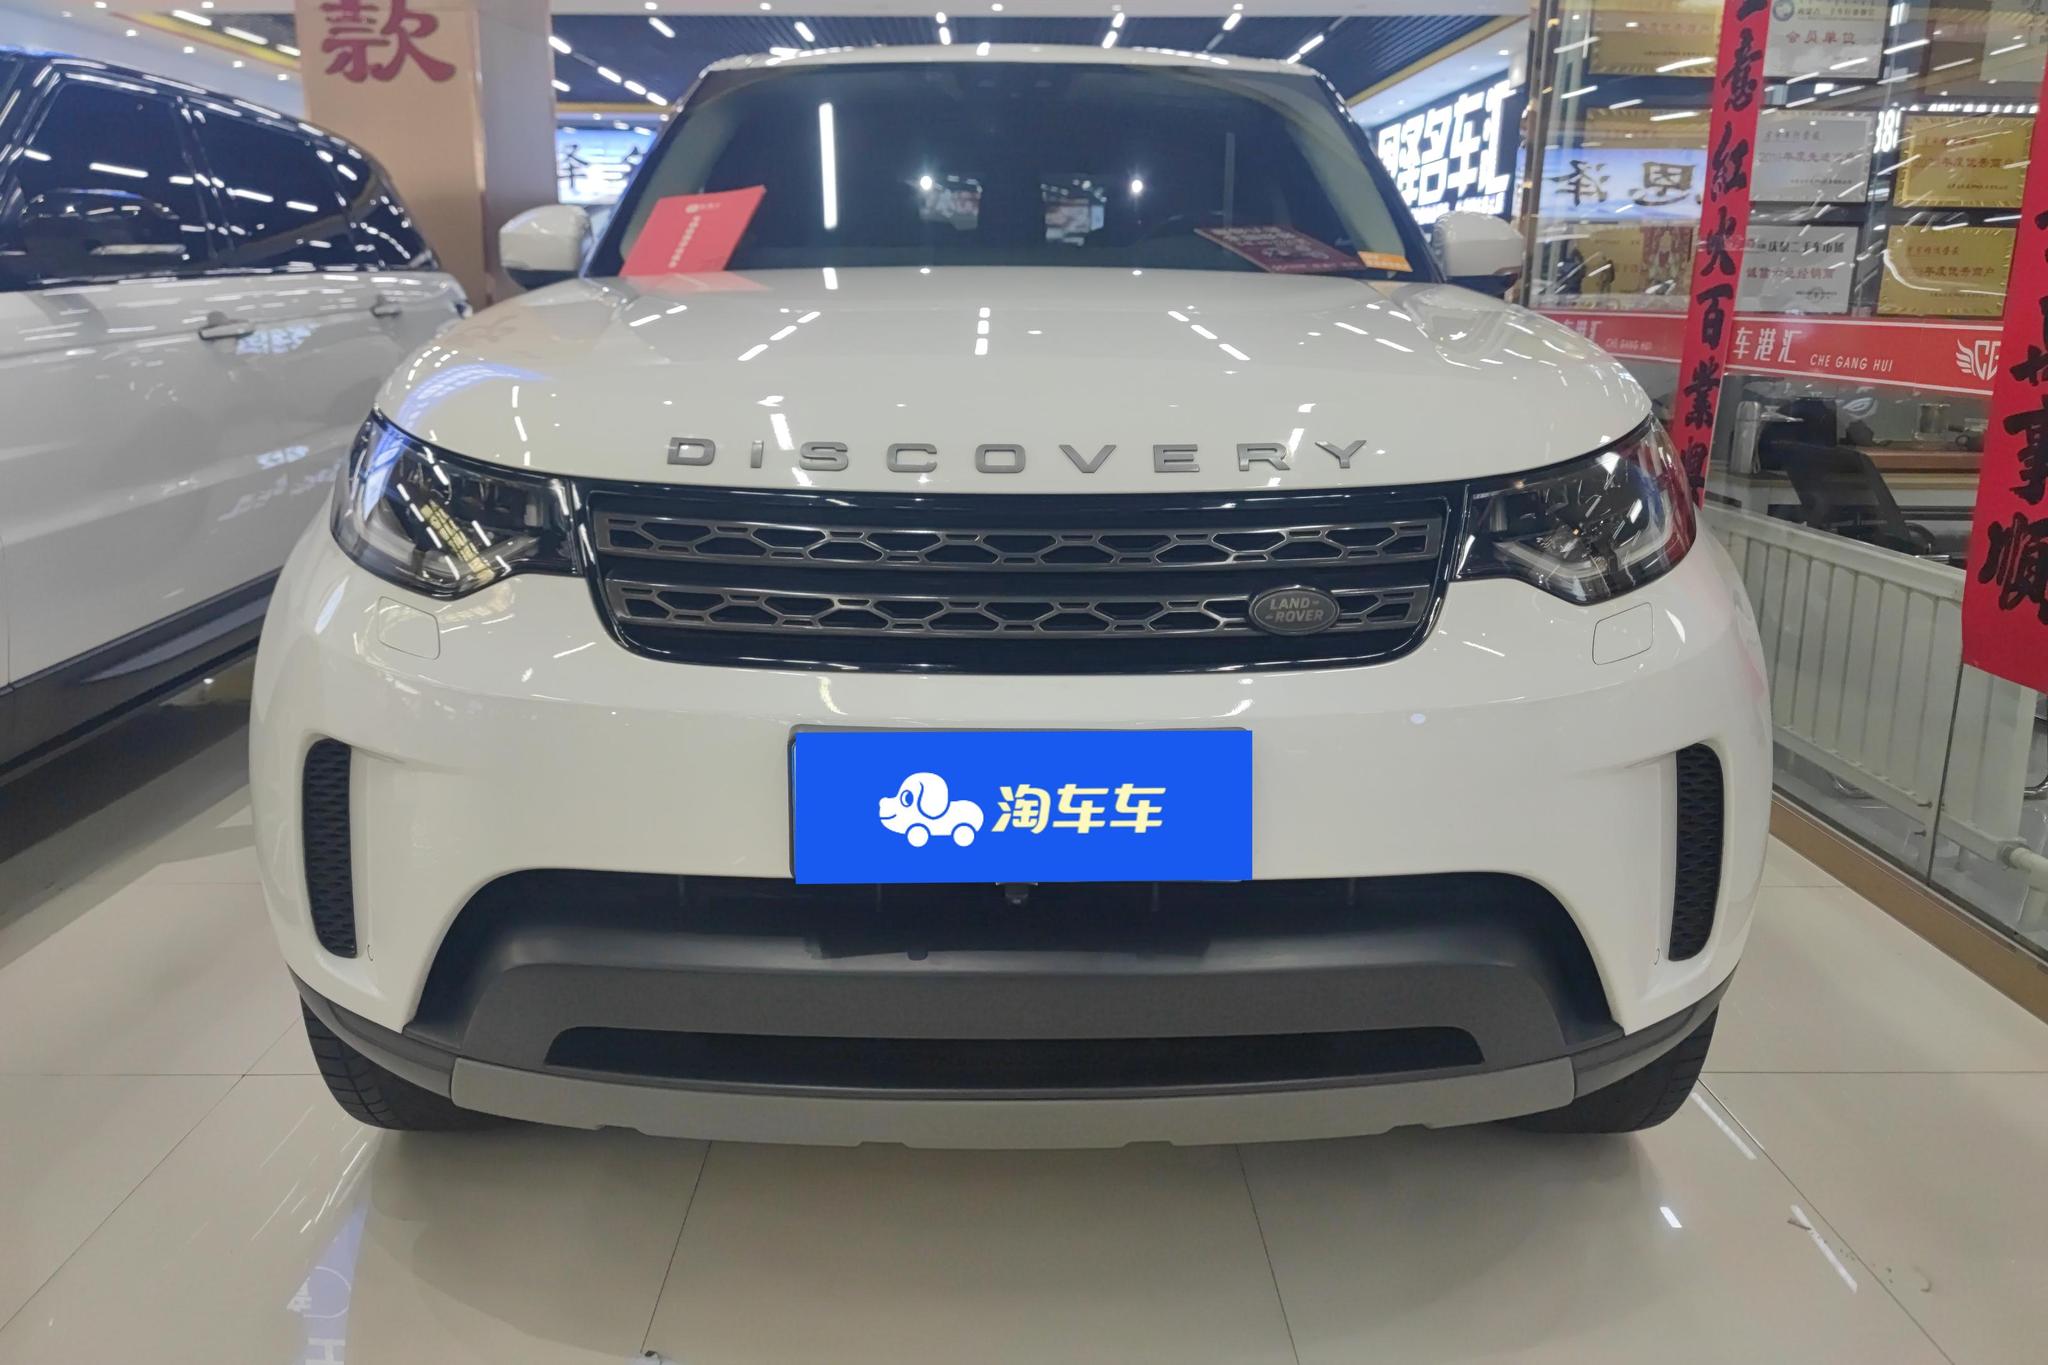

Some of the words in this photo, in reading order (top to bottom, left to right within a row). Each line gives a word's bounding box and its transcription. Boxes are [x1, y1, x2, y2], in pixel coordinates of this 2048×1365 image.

[320, 0, 457, 83] 款
[1732, 326, 1803, 364] 车港汇
[1809, 354, 1830, 368] CHE
[1835, 356, 1868, 371] GANG
[1873, 360, 1893, 373] HUI
[667, 436, 1367, 474] DISCOVERY
